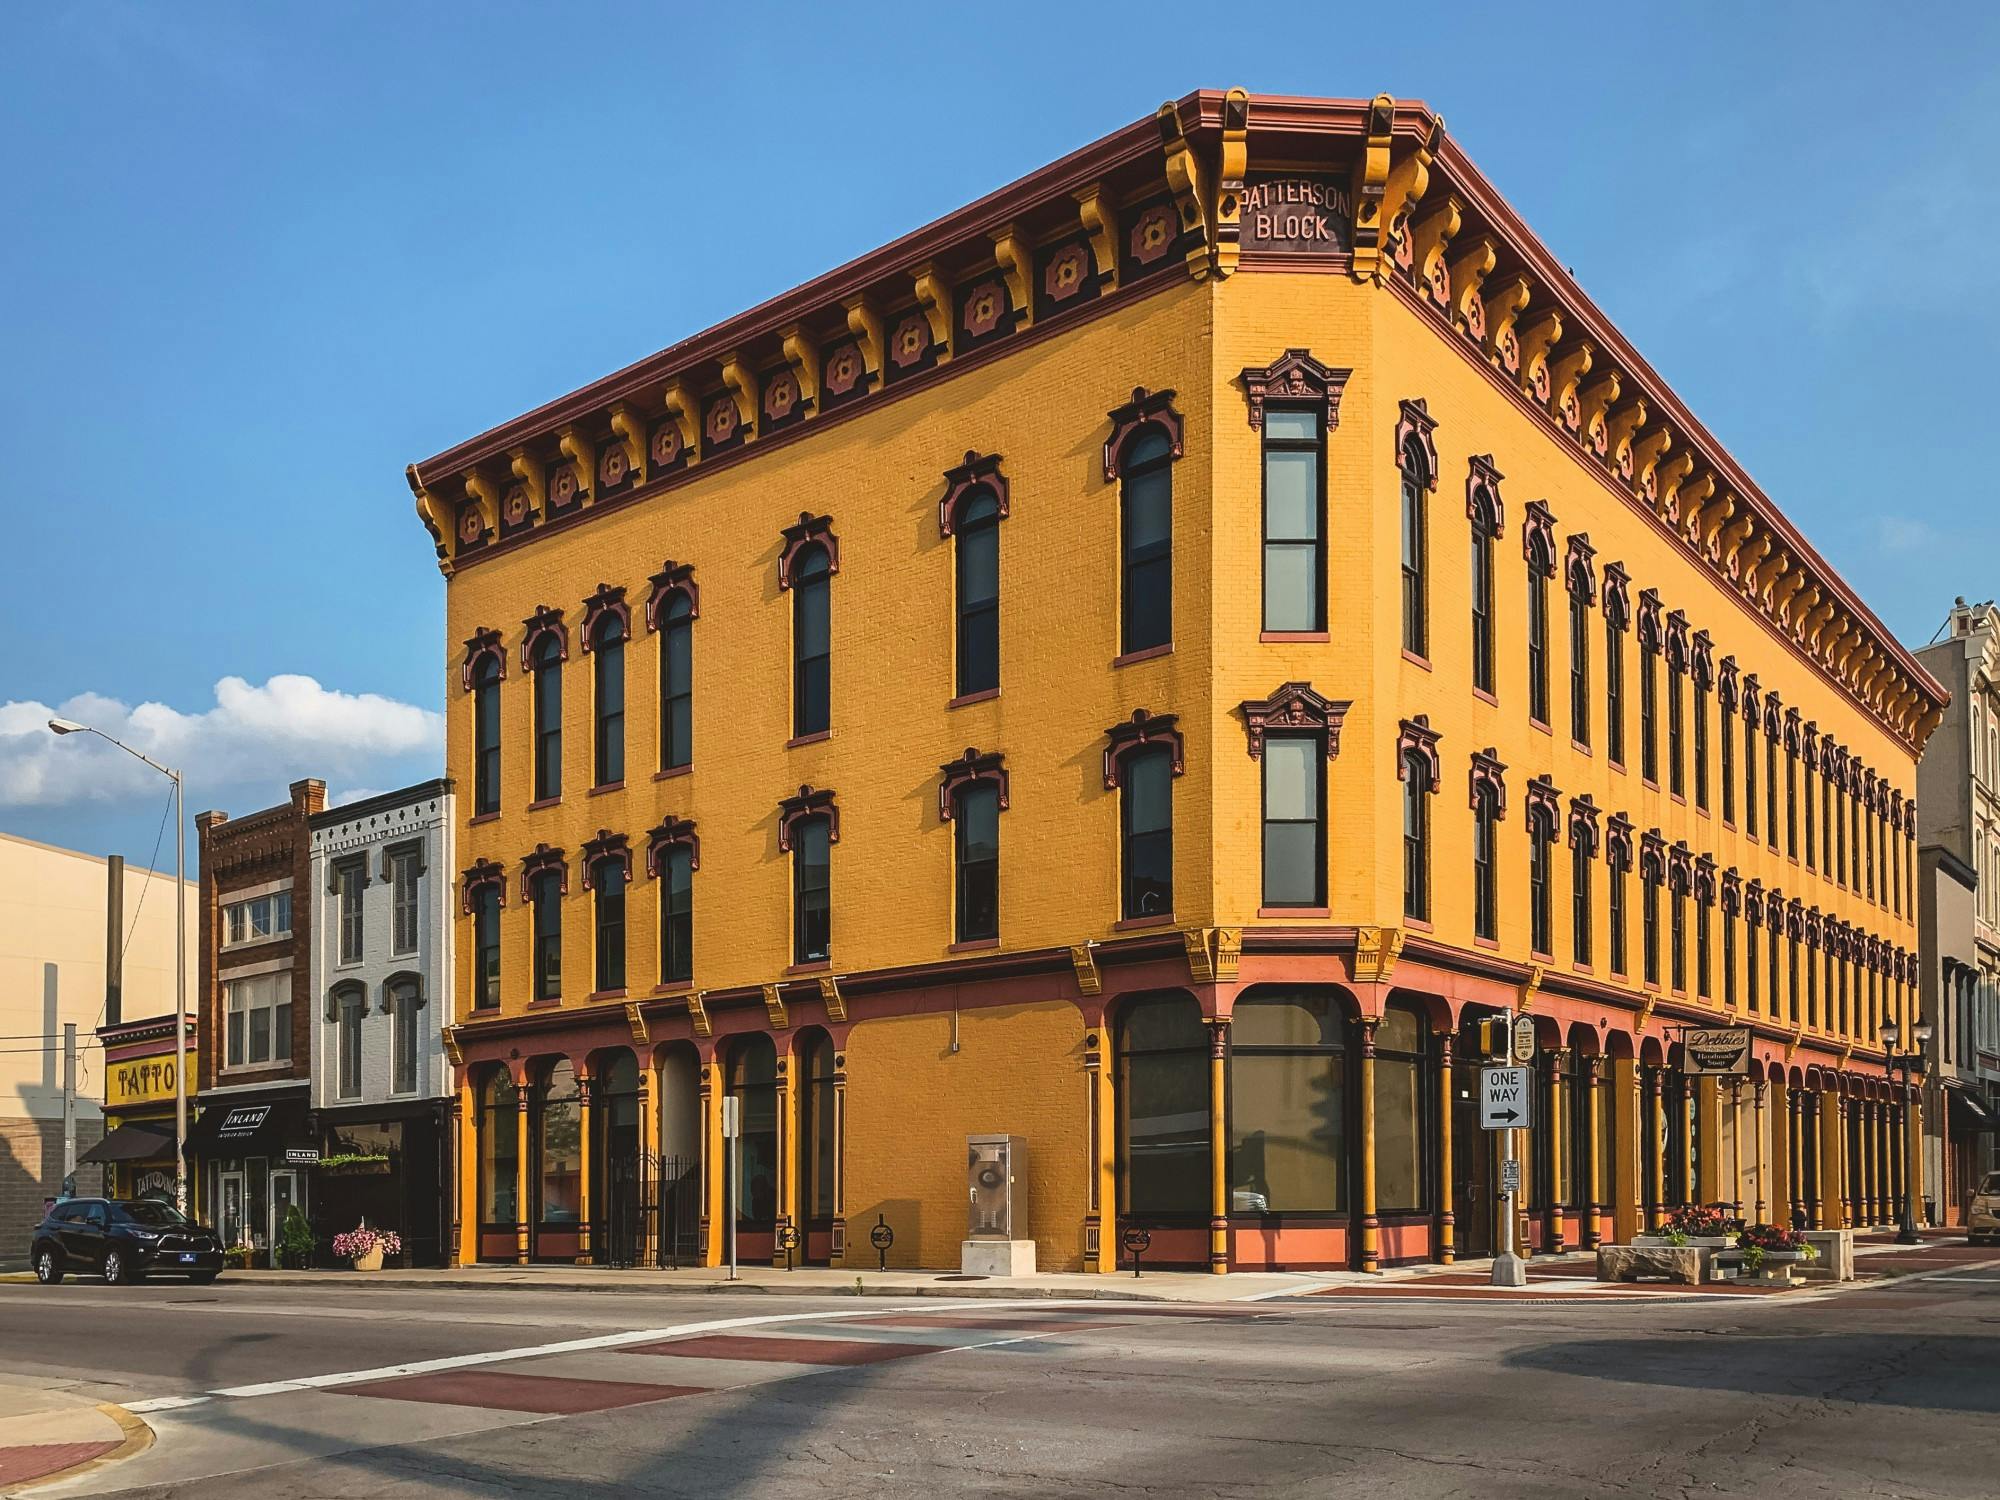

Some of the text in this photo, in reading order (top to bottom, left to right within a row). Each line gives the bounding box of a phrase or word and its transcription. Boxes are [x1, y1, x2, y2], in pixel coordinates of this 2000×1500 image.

[1257, 215, 1330, 240] BLOCK
[118, 1062, 178, 1096] TATTO
[1490, 1071, 1519, 1086] ONE
[1489, 1088, 1519, 1103] WAY
[227, 1112, 264, 1125] INLAND
